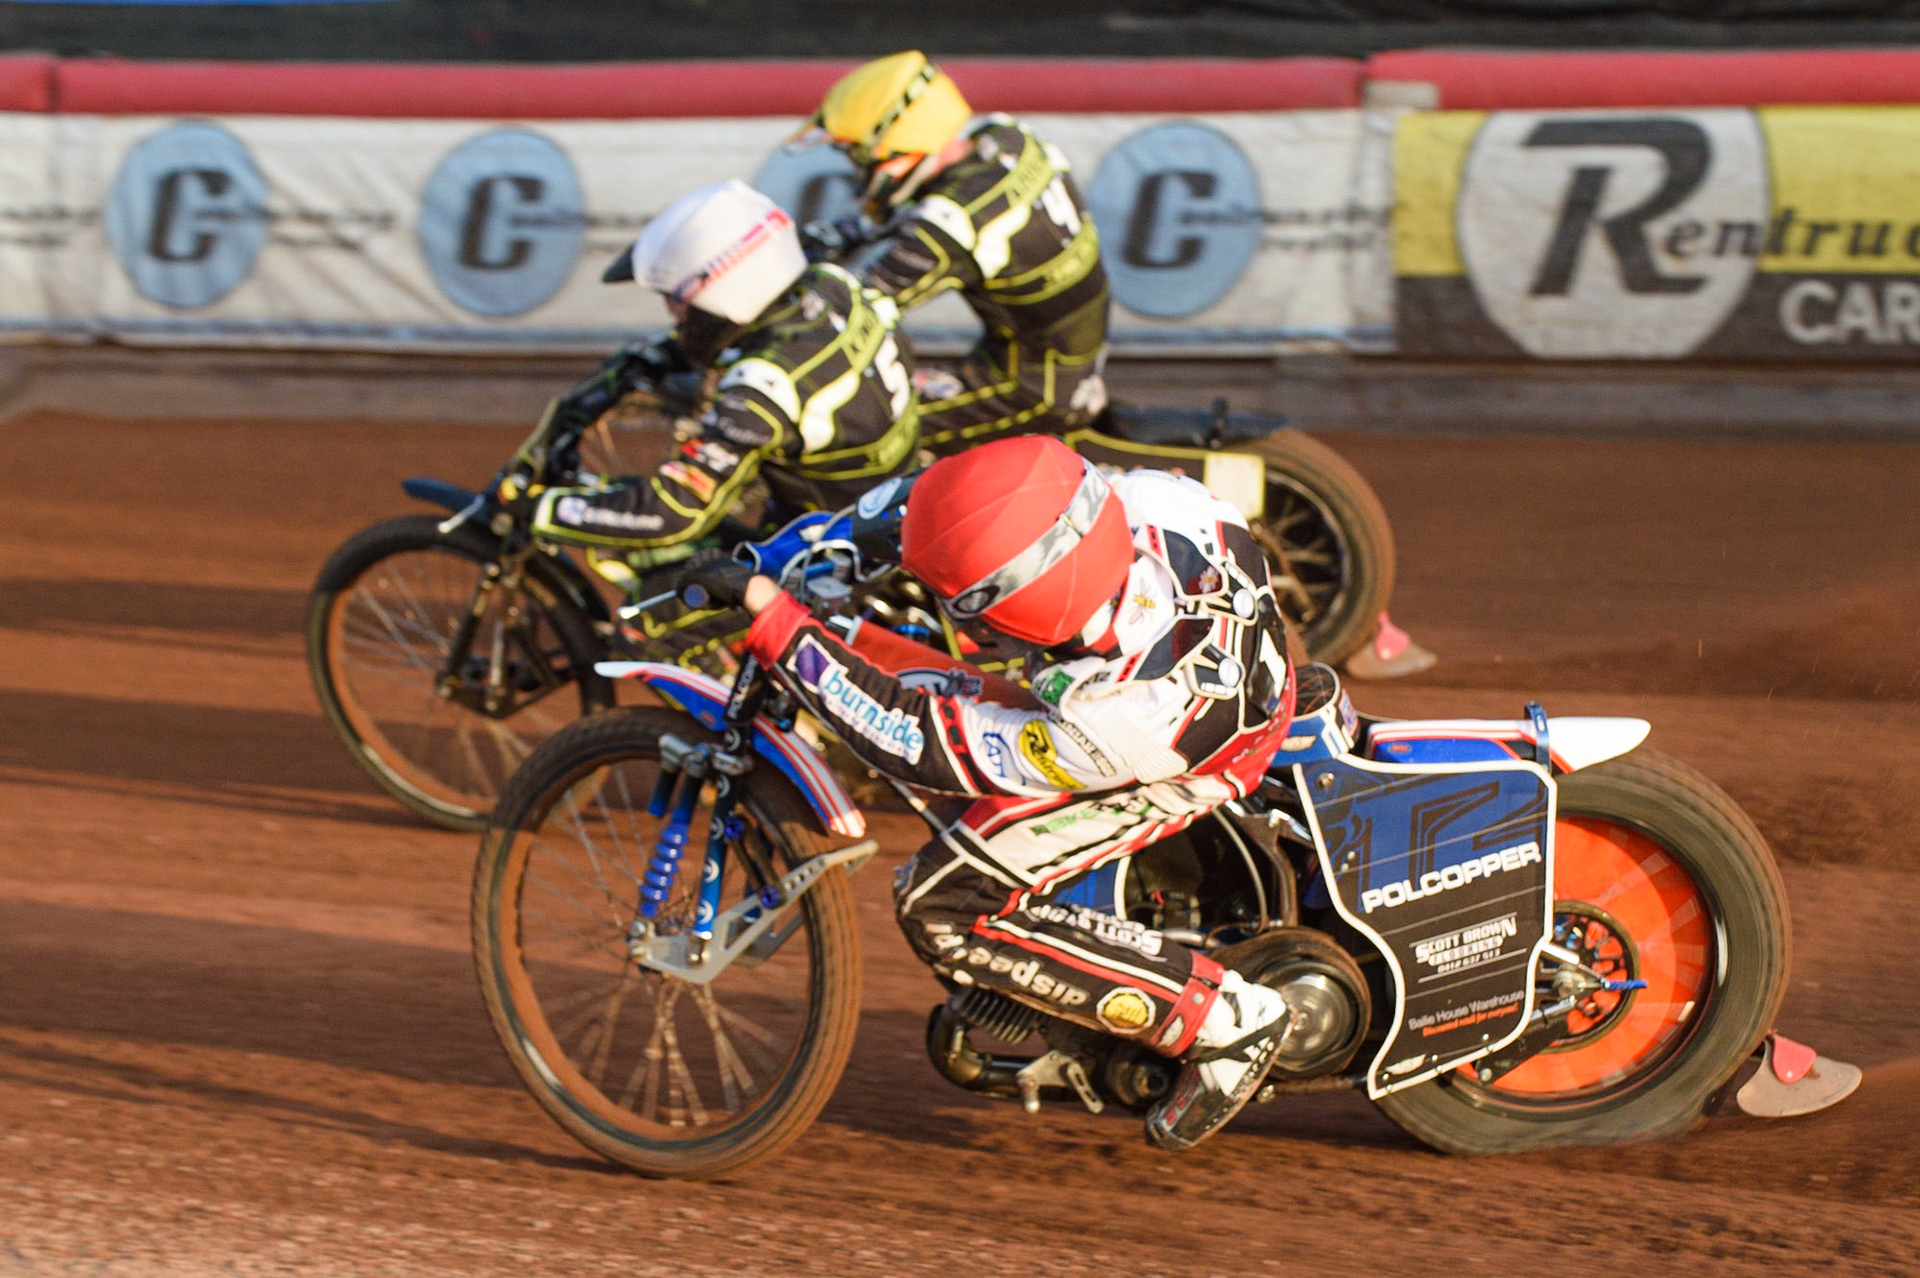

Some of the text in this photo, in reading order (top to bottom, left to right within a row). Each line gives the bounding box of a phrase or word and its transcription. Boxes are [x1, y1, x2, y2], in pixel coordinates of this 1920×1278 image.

[823, 668, 924, 751] burnside
[1361, 841, 1543, 914] POLCOPPER
[1415, 933, 1460, 964] SCOTT
[1462, 916, 1518, 945] BROWN
